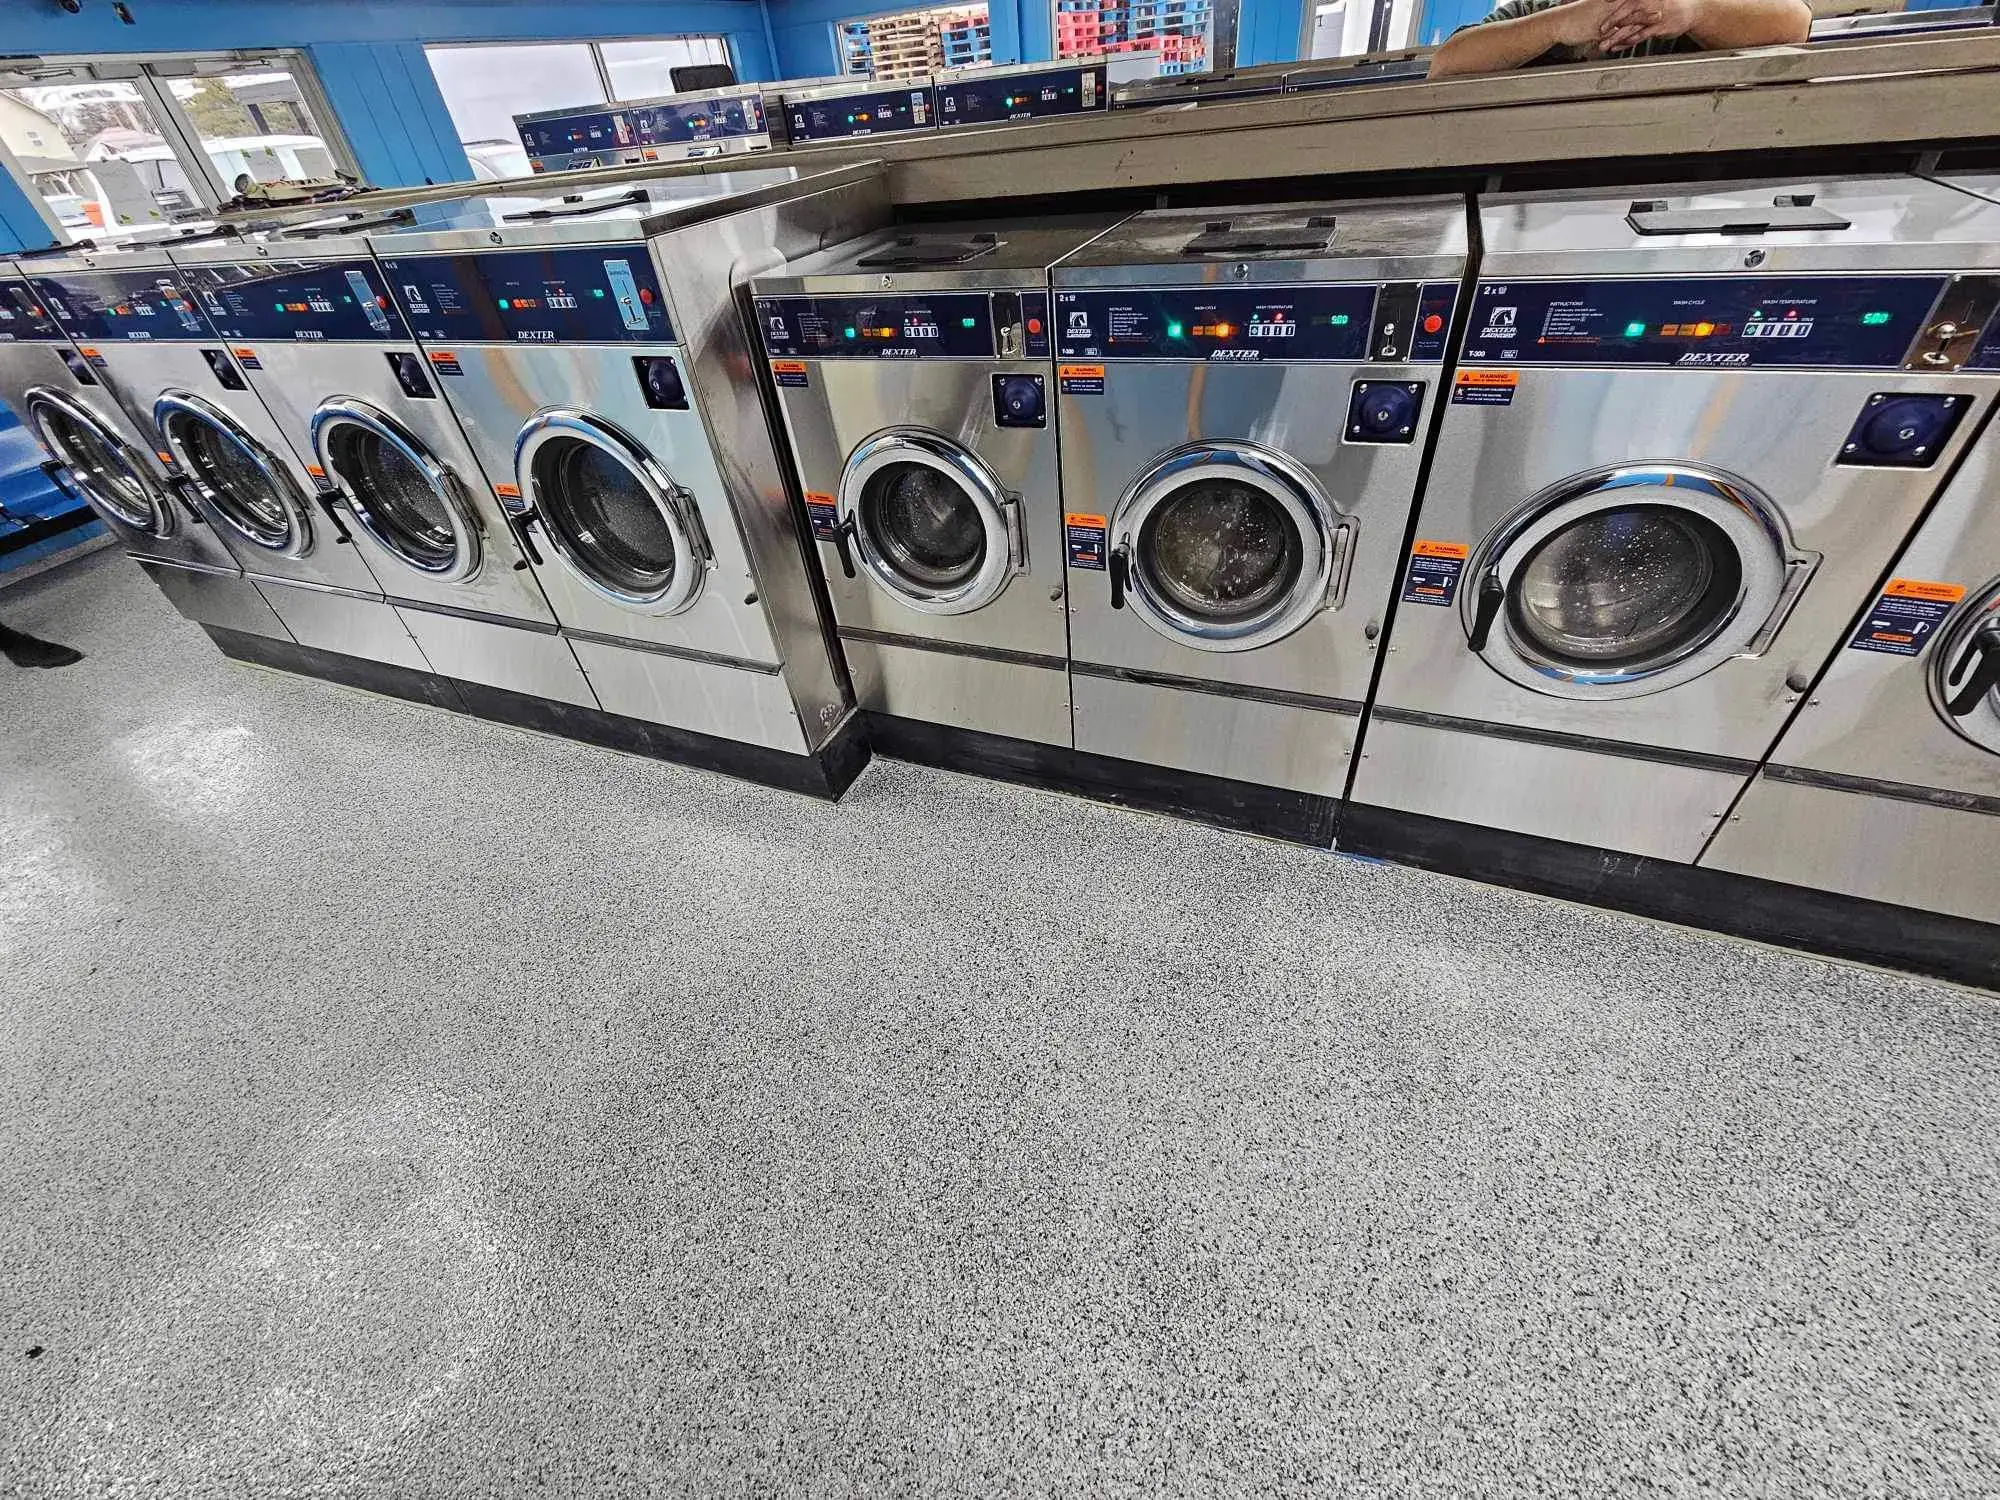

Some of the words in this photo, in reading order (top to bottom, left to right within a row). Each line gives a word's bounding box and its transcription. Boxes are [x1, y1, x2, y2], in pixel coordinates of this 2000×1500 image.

[295, 330, 324, 339] DEXTER
[518, 331, 555, 339] DEXTER
[881, 348, 917, 356] DEXTER
[1210, 349, 1260, 358] DEXTER
[1679, 353, 1751, 362] DEXTER
